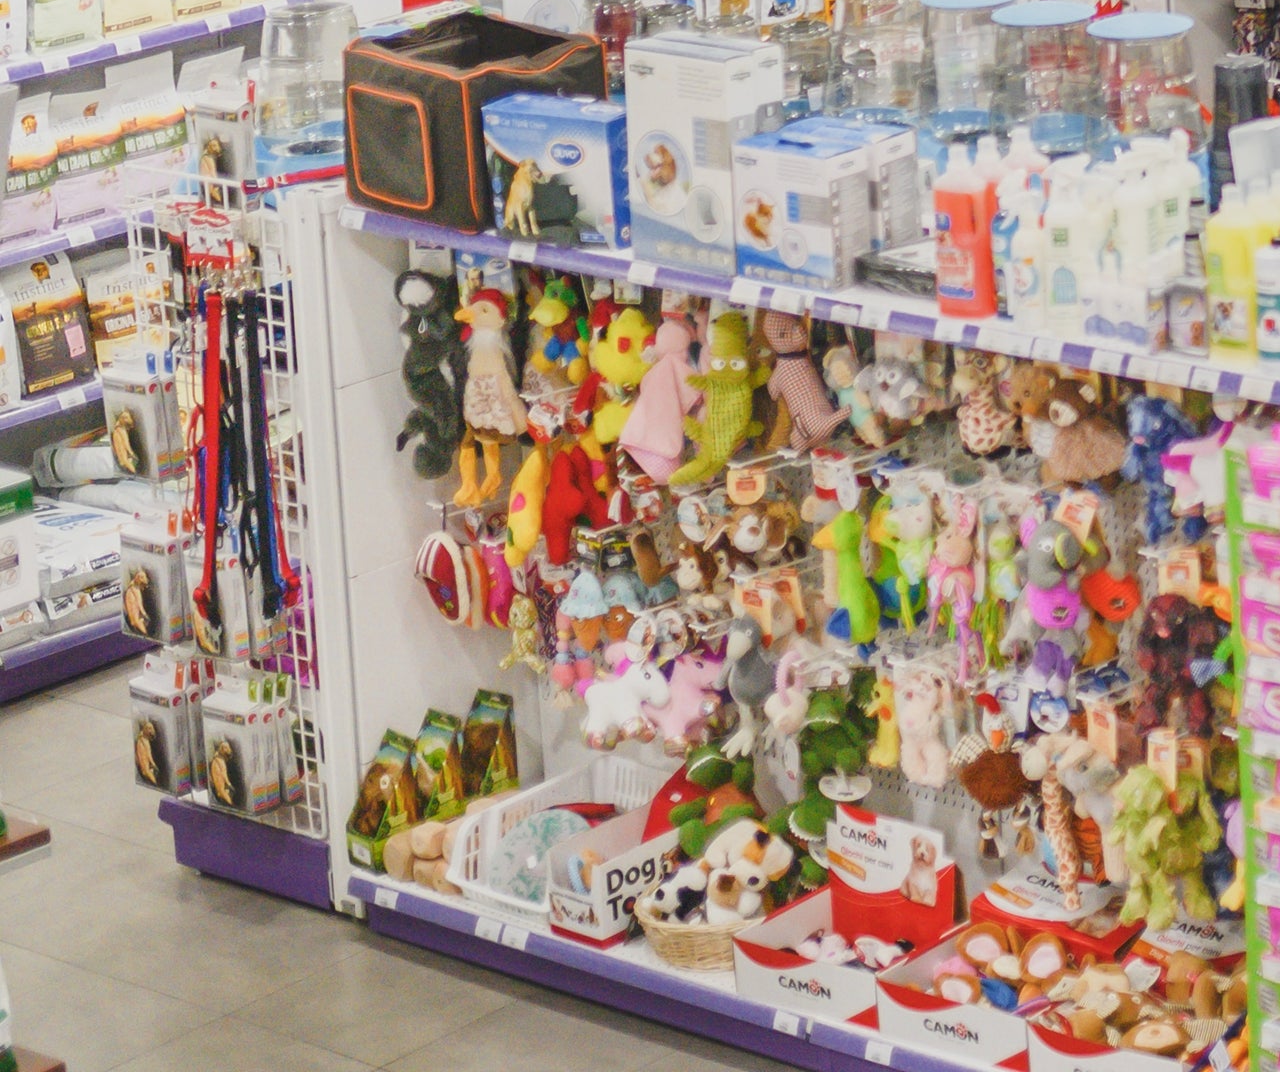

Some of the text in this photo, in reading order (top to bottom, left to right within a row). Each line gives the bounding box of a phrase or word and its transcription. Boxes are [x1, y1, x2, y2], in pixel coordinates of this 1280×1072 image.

[13, 276, 67, 305] Instinct
[841, 825, 888, 851] CAMON
[864, 853, 878, 868] per
[878, 857, 894, 871] cani
[606, 856, 657, 896] Dog
[1175, 921, 1225, 943] AMON
[778, 974, 832, 1001] CAMON
[923, 1018, 979, 1045] CAMON
